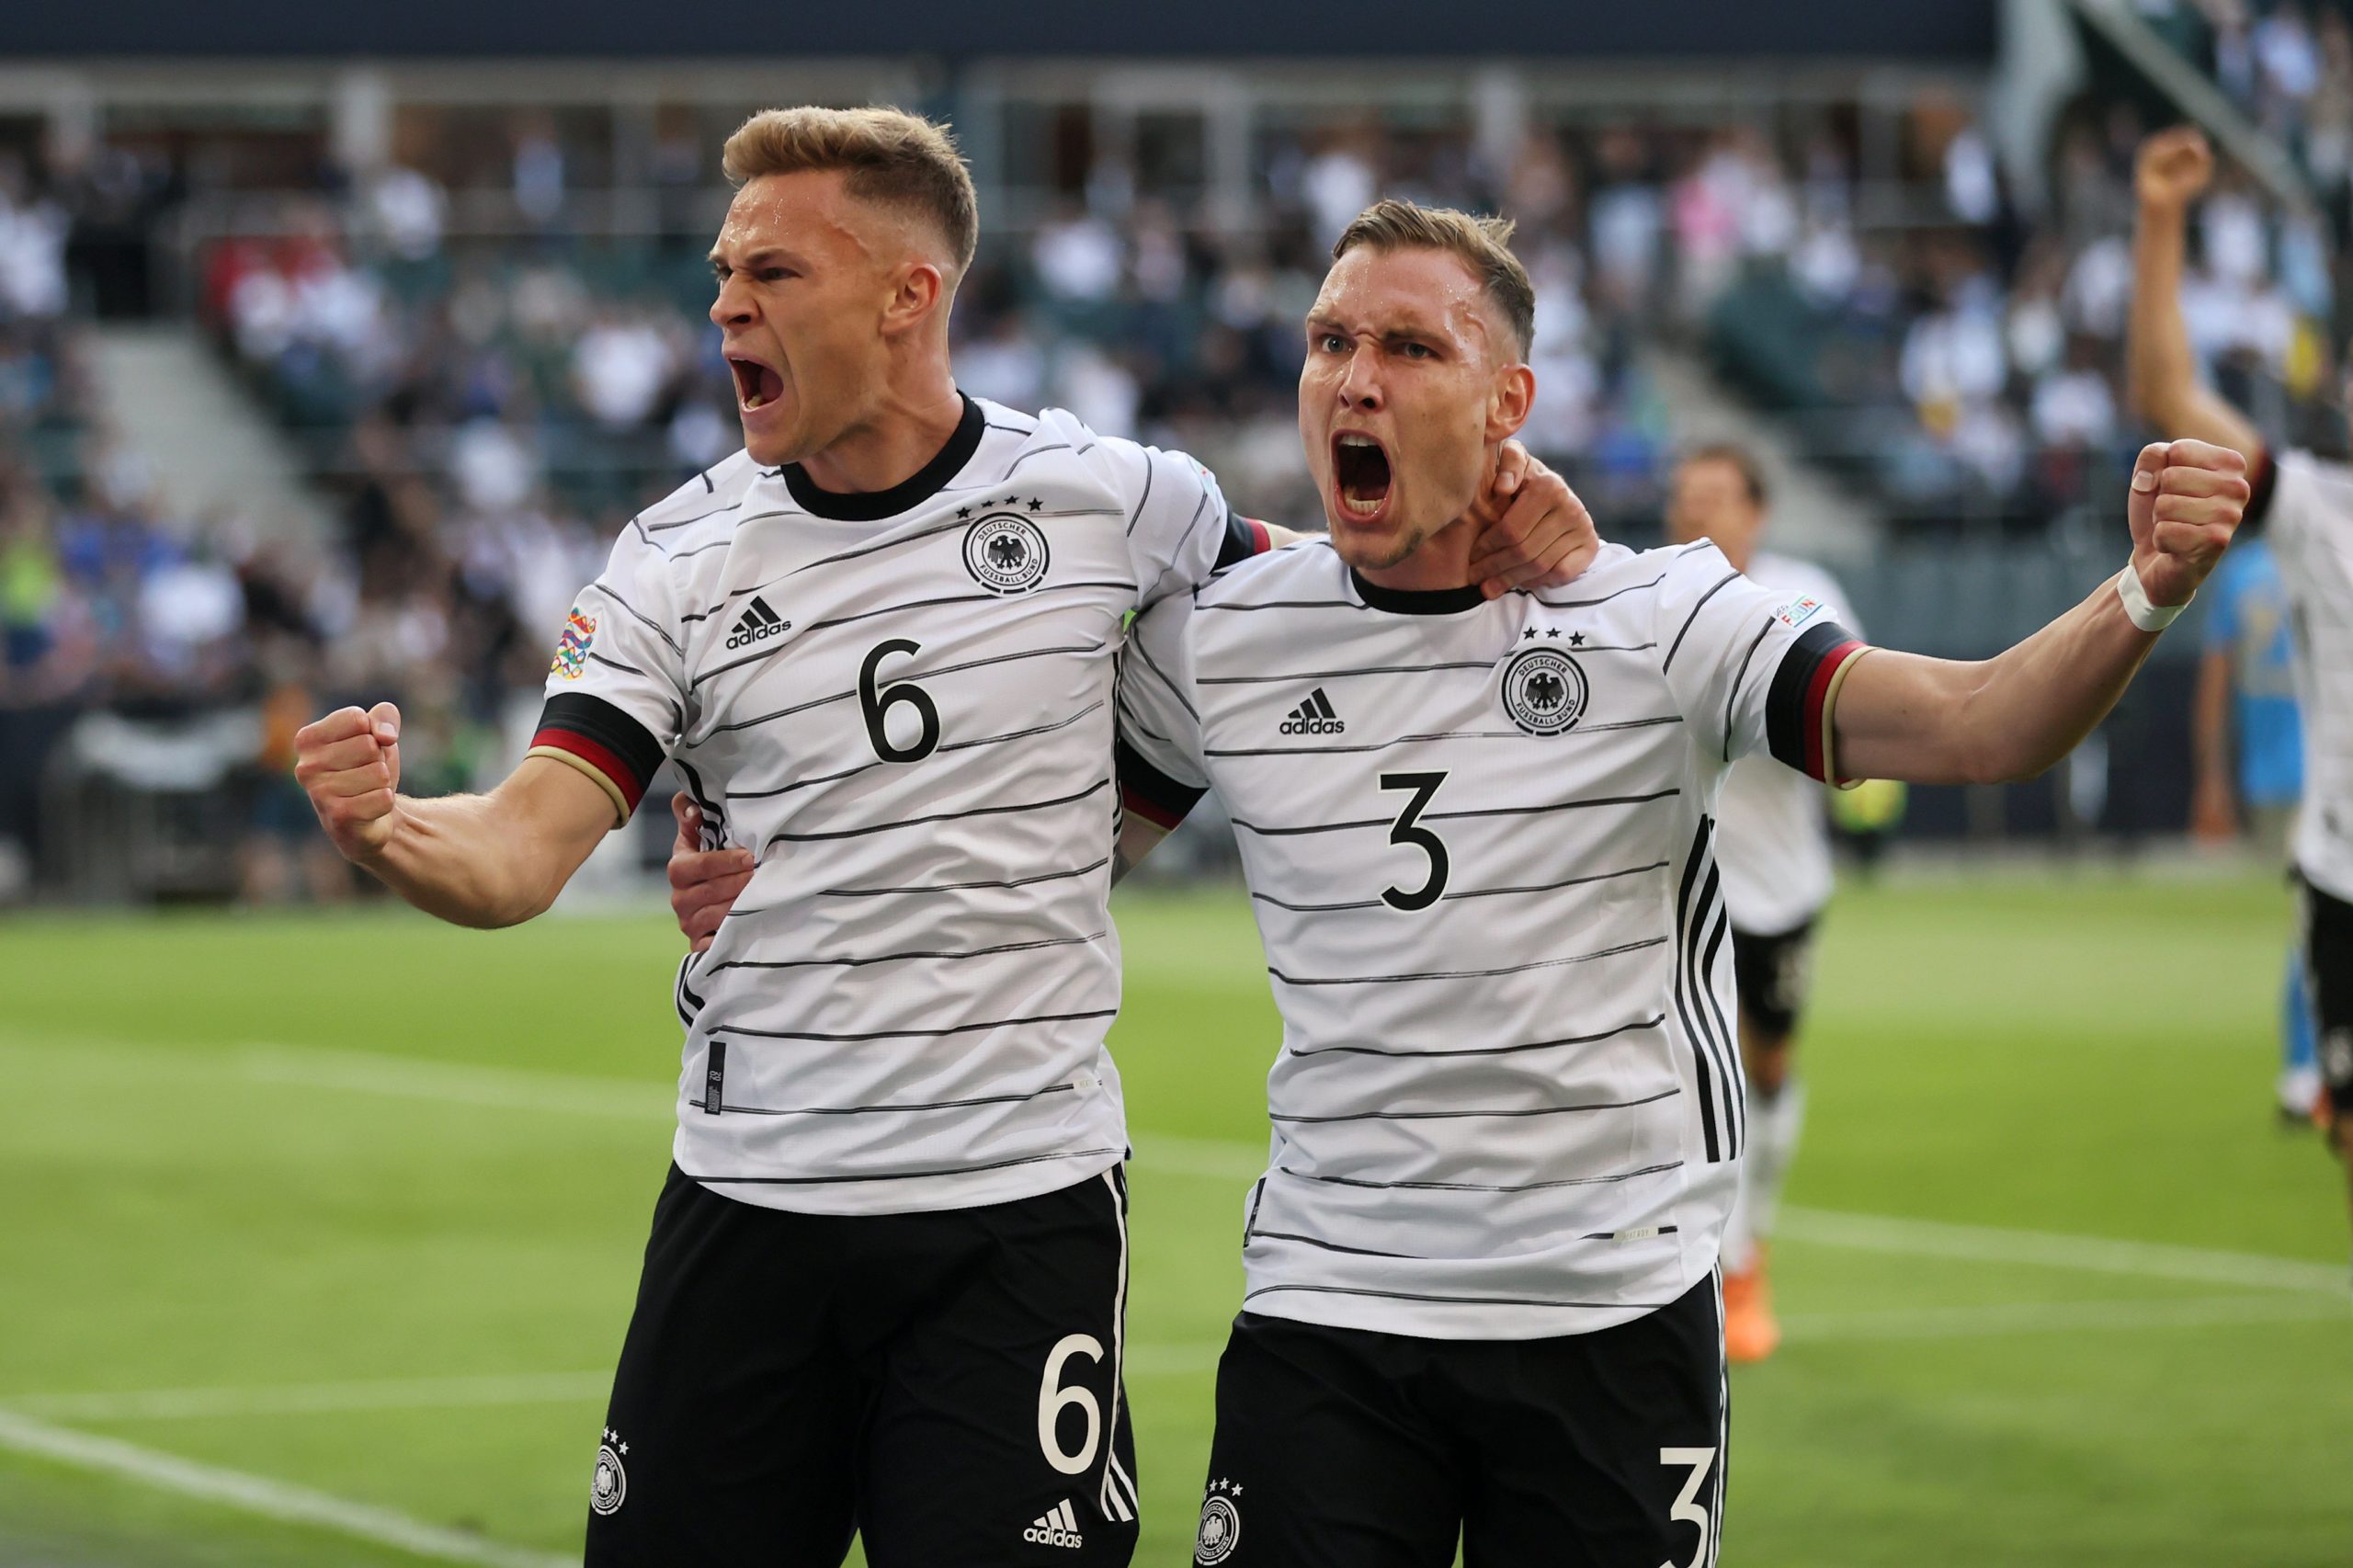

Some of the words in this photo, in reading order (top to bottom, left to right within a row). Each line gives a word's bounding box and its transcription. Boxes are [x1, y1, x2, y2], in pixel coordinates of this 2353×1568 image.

[978, 521, 1027, 540] DEUTSCHER
[980, 558, 1038, 584] FUSSBALL-BUND
[725, 620, 791, 650] adidas
[1518, 658, 1567, 676] DEUTSCHER
[858, 638, 940, 763] 6
[1516, 699, 1575, 725] FUSSBALL-BUND
[1279, 718, 1345, 734] adidas
[1379, 770, 1450, 912] 3
[1038, 1333, 1105, 1475] 6
[1658, 1447, 1717, 1568] 3
[1022, 1525, 1084, 1550] adidas
